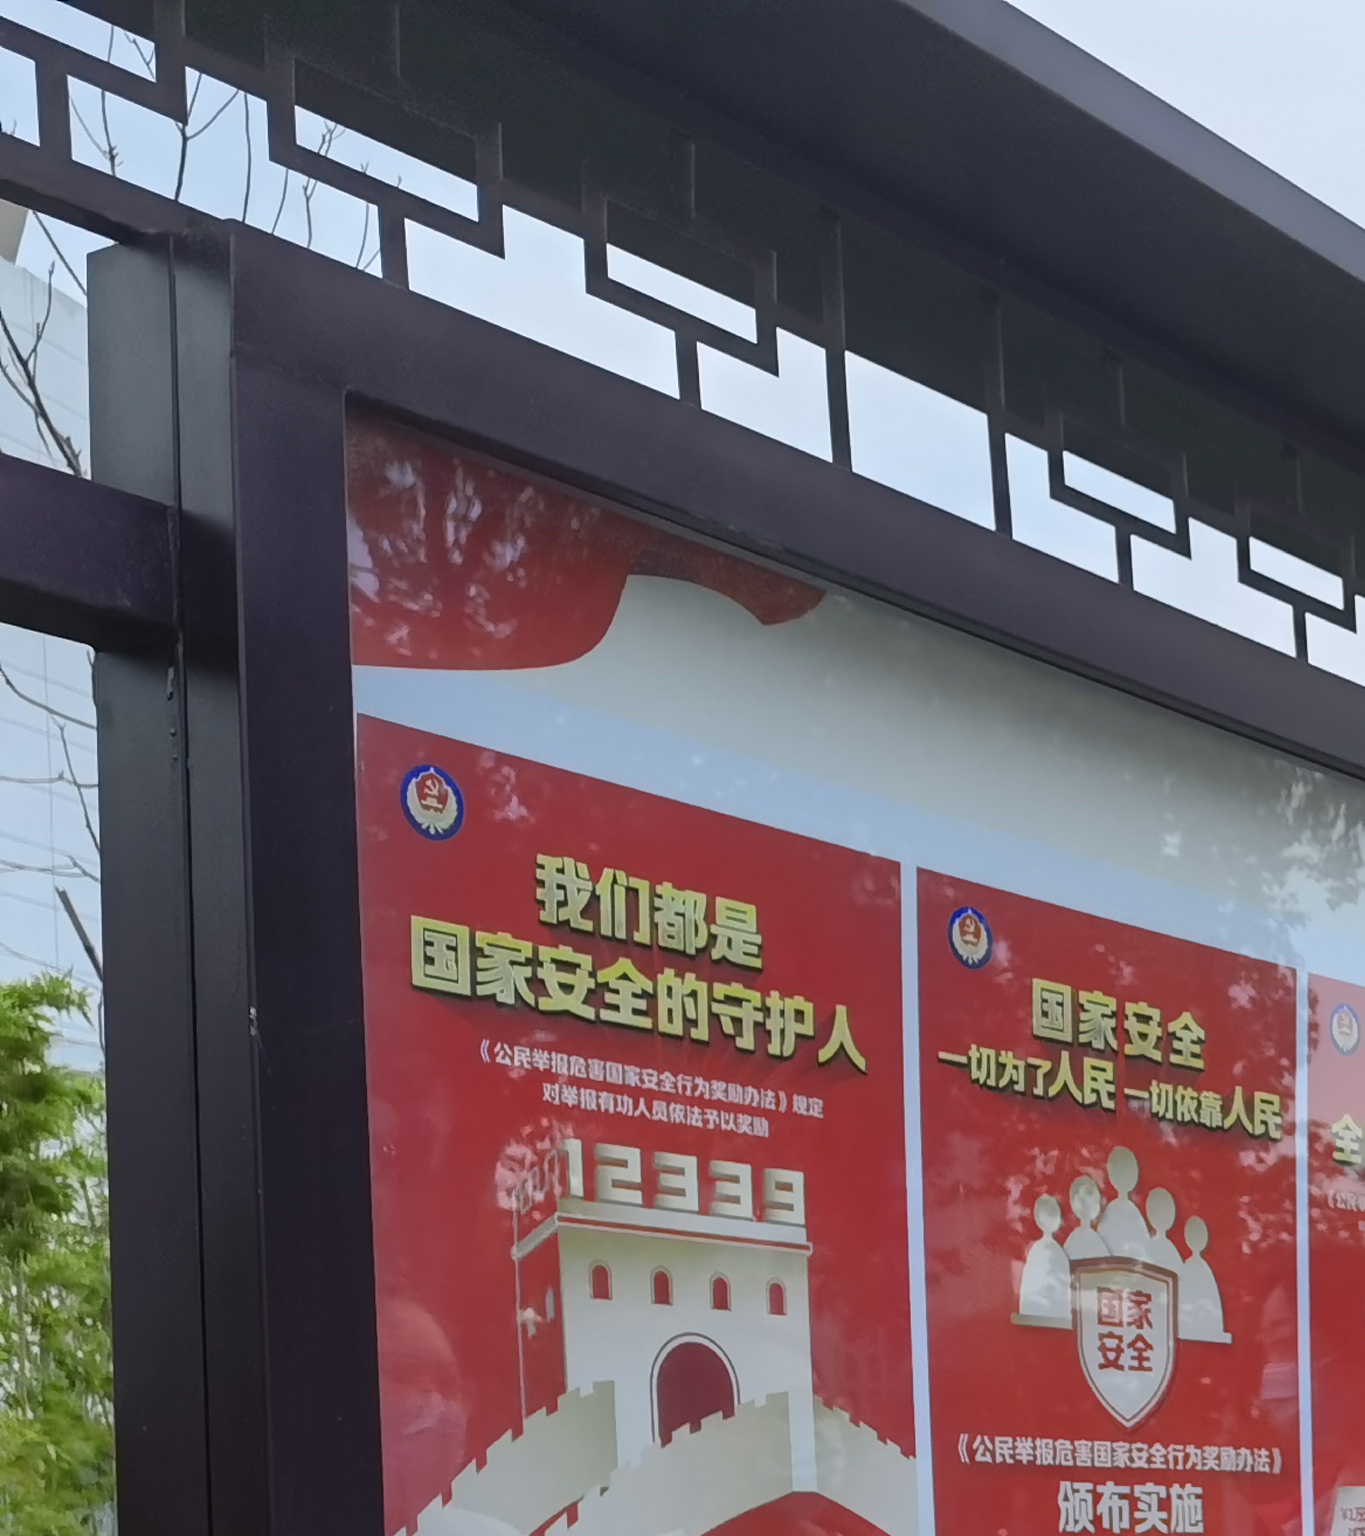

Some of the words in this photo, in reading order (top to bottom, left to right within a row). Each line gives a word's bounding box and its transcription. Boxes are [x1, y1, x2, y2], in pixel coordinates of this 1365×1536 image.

[535, 853, 763, 970] 我们都是
[410, 914, 867, 1073] 国家安全的守护人
[1031, 977, 1206, 1071] 国家安全
[480, 1038, 789, 1114] 《公民举报危害国家安全行为奖励办法》
[542, 1081, 770, 1139] 对举报有功人员依法予以奖励
[937, 1042, 1117, 1112] 一切为了人民
[1123, 1078, 1284, 1141] 一切依靠人民
[560, 1137, 807, 1226] 12339
[1095, 1287, 1154, 1331] 国家
[1095, 1332, 1154, 1373] 安全
[957, 1433, 1281, 1474] 《公民举报危害国家安全行为奖励办法》
[1057, 1481, 1204, 1534] 颁布实施
